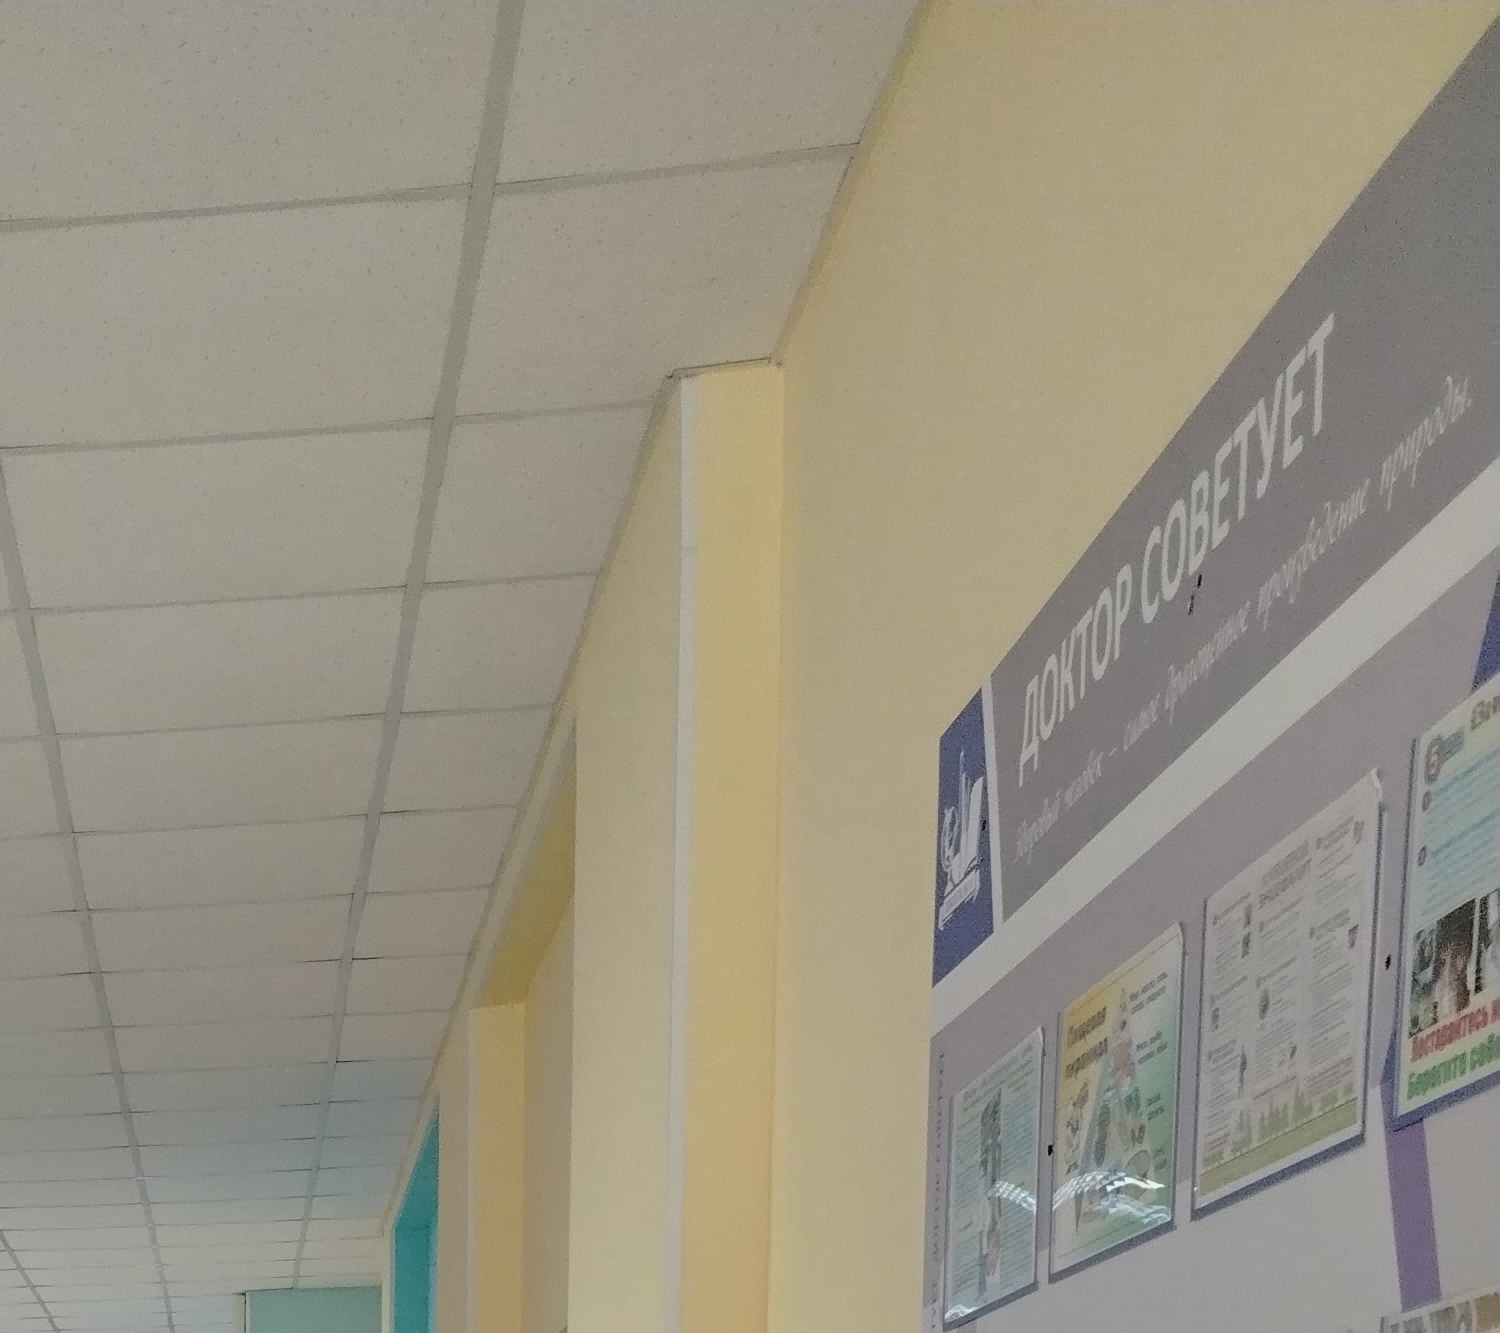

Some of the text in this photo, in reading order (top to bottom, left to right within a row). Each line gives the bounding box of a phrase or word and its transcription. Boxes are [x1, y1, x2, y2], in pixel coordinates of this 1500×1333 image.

[1019, 312, 1334, 788] ДОКТОР СОВЕТУЕТ
[1257, 477, 1370, 632] произведение
[1379, 375, 1473, 512] природы.
